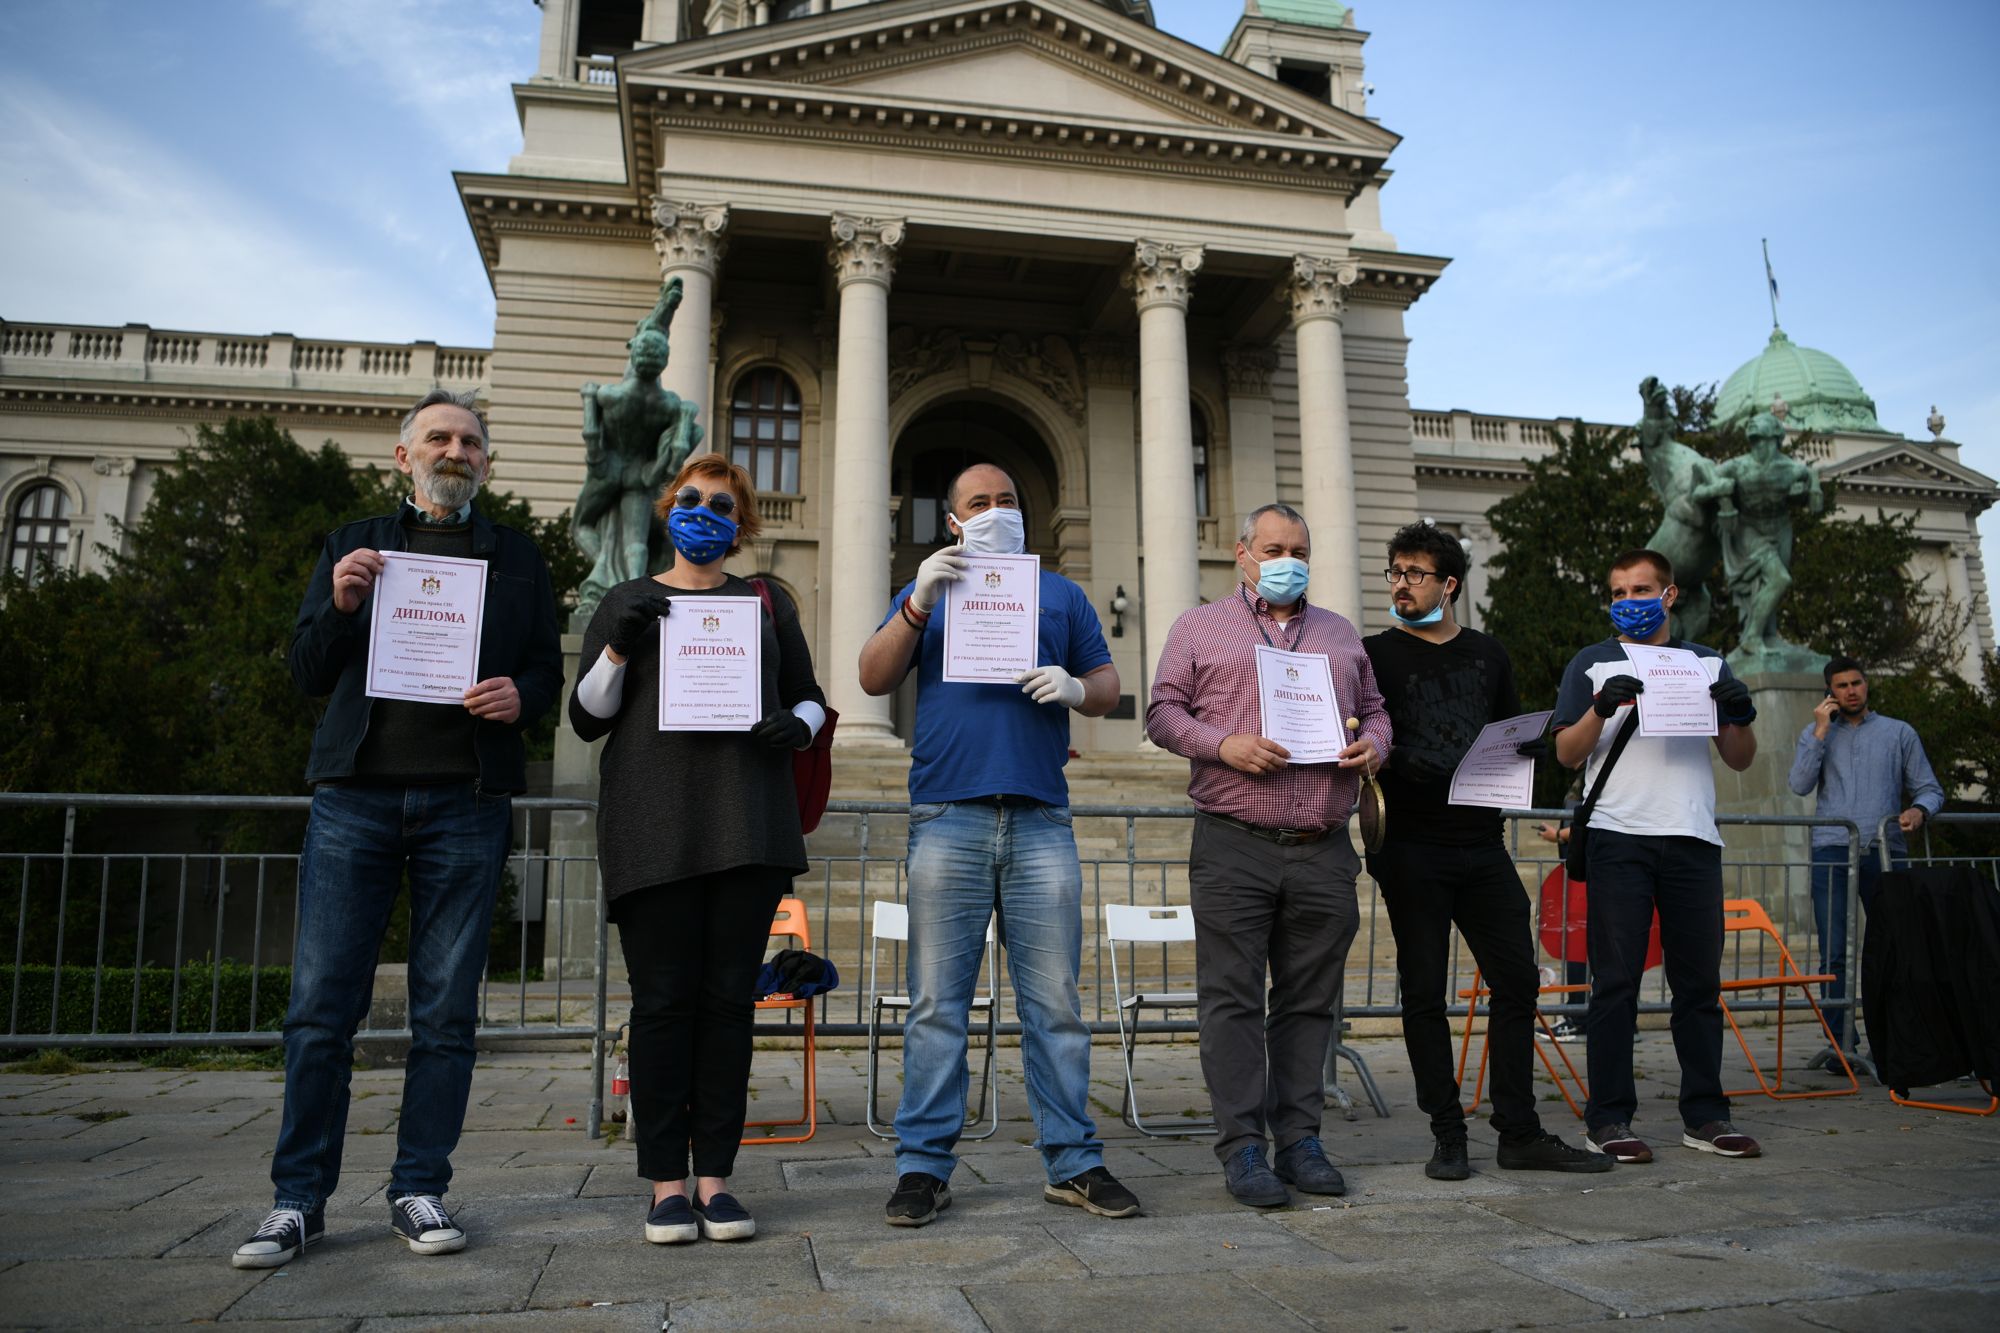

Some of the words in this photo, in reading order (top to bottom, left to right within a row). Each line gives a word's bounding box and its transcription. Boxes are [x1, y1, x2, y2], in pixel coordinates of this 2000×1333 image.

[962, 601, 1024, 612] ДИПЛОМА
[392, 607, 466, 623] ДИПЛОМА
[679, 646, 745, 656] ДИПЛОМА
[1648, 669, 1700, 677] ДИПЛОМА
[1273, 689, 1323, 702] ДИПЛОМА
